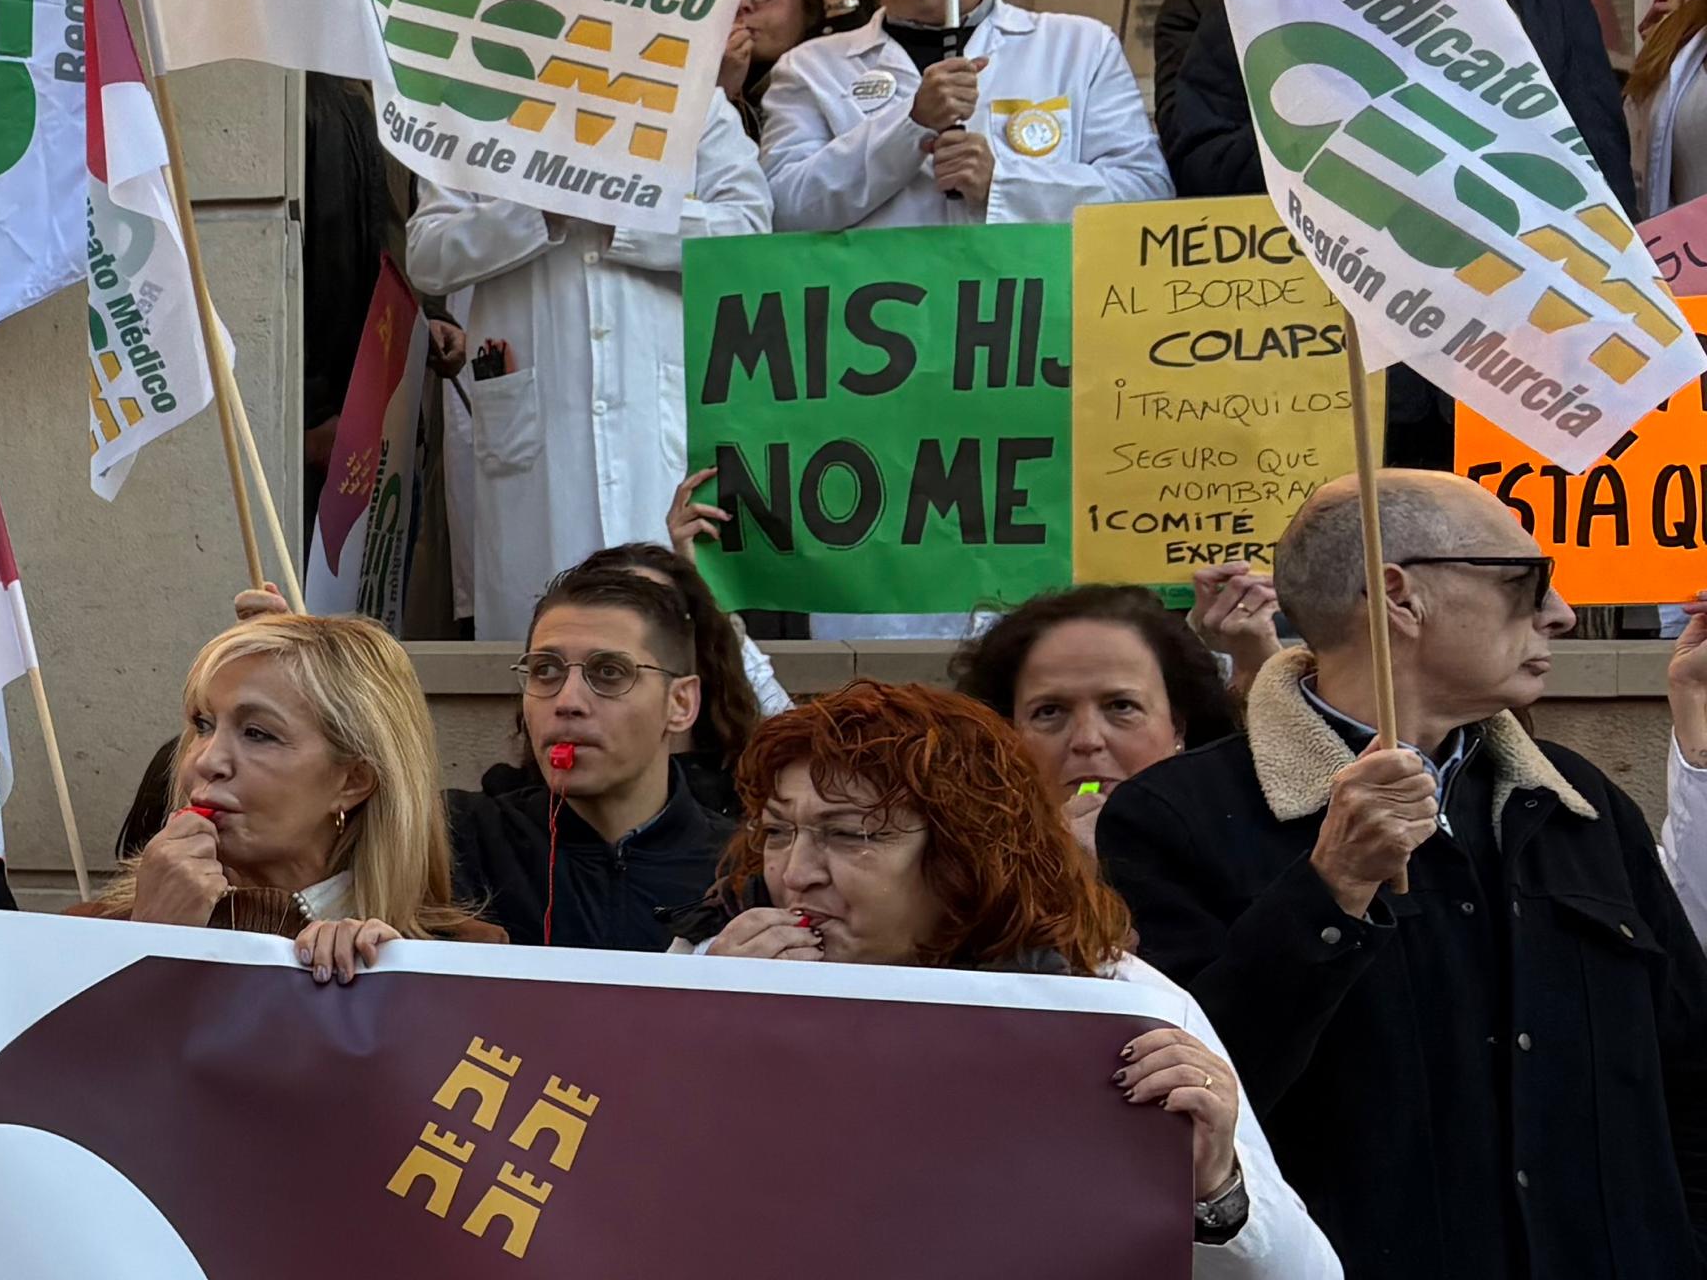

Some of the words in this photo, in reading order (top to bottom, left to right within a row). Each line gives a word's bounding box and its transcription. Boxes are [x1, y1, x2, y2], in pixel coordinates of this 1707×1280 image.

[466, 136, 516, 174] de
[523, 149, 663, 209] Murcia
[105, 292, 177, 414] Médico
[701, 281, 929, 406] MIS
[1100, 284, 1148, 318] AL
[1164, 277, 1305, 315] BORDE
[1287, 188, 1386, 304] Región
[1386, 287, 1446, 338] de
[1441, 317, 1604, 439] Murcia
[717, 435, 887, 555] NO
[901, 436, 1054, 547] ME
[1106, 442, 1238, 475] SEGURO
[1257, 448, 1320, 476] QUE
